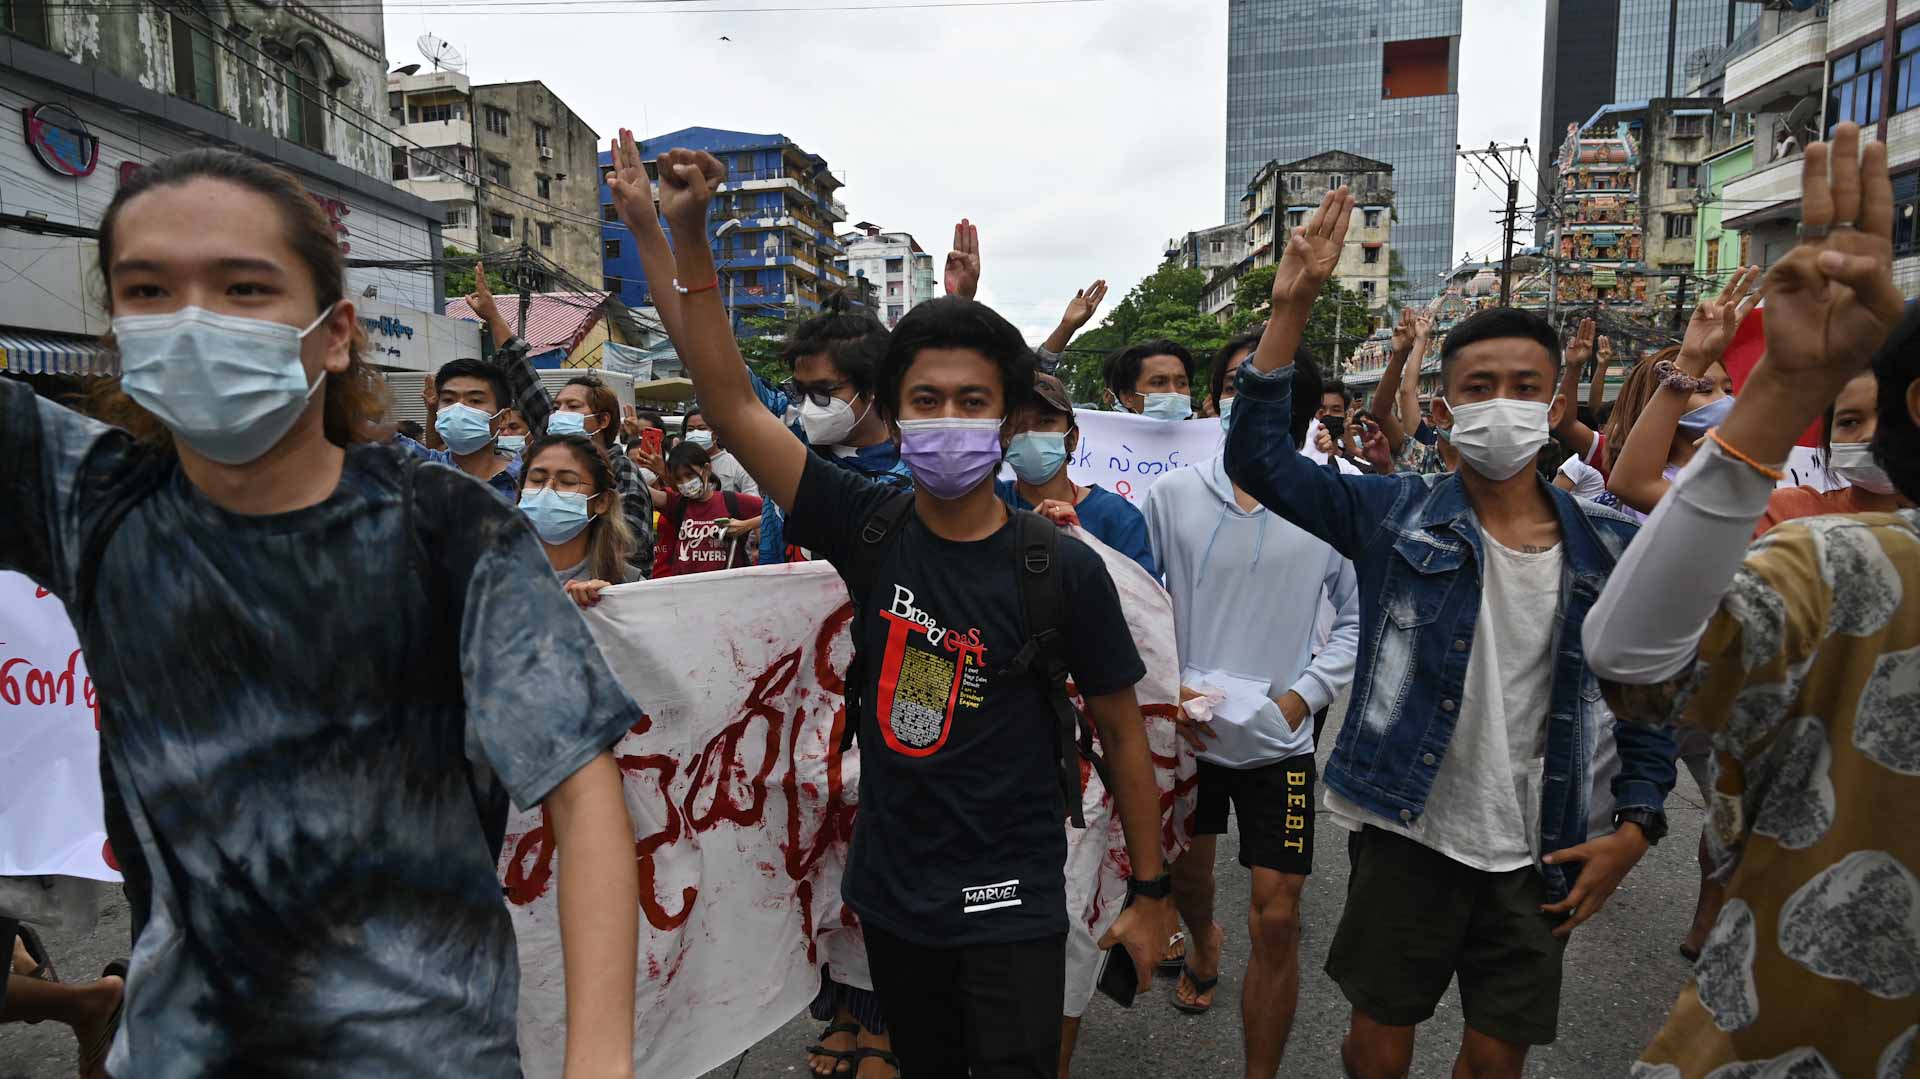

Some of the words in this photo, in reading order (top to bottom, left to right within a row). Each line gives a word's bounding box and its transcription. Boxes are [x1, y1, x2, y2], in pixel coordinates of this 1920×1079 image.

[679, 519, 728, 548] Super
[692, 550, 727, 561] FLYERS
[1284, 771, 1306, 854] B.E.B.T
[965, 886, 1017, 904] MARVEL
